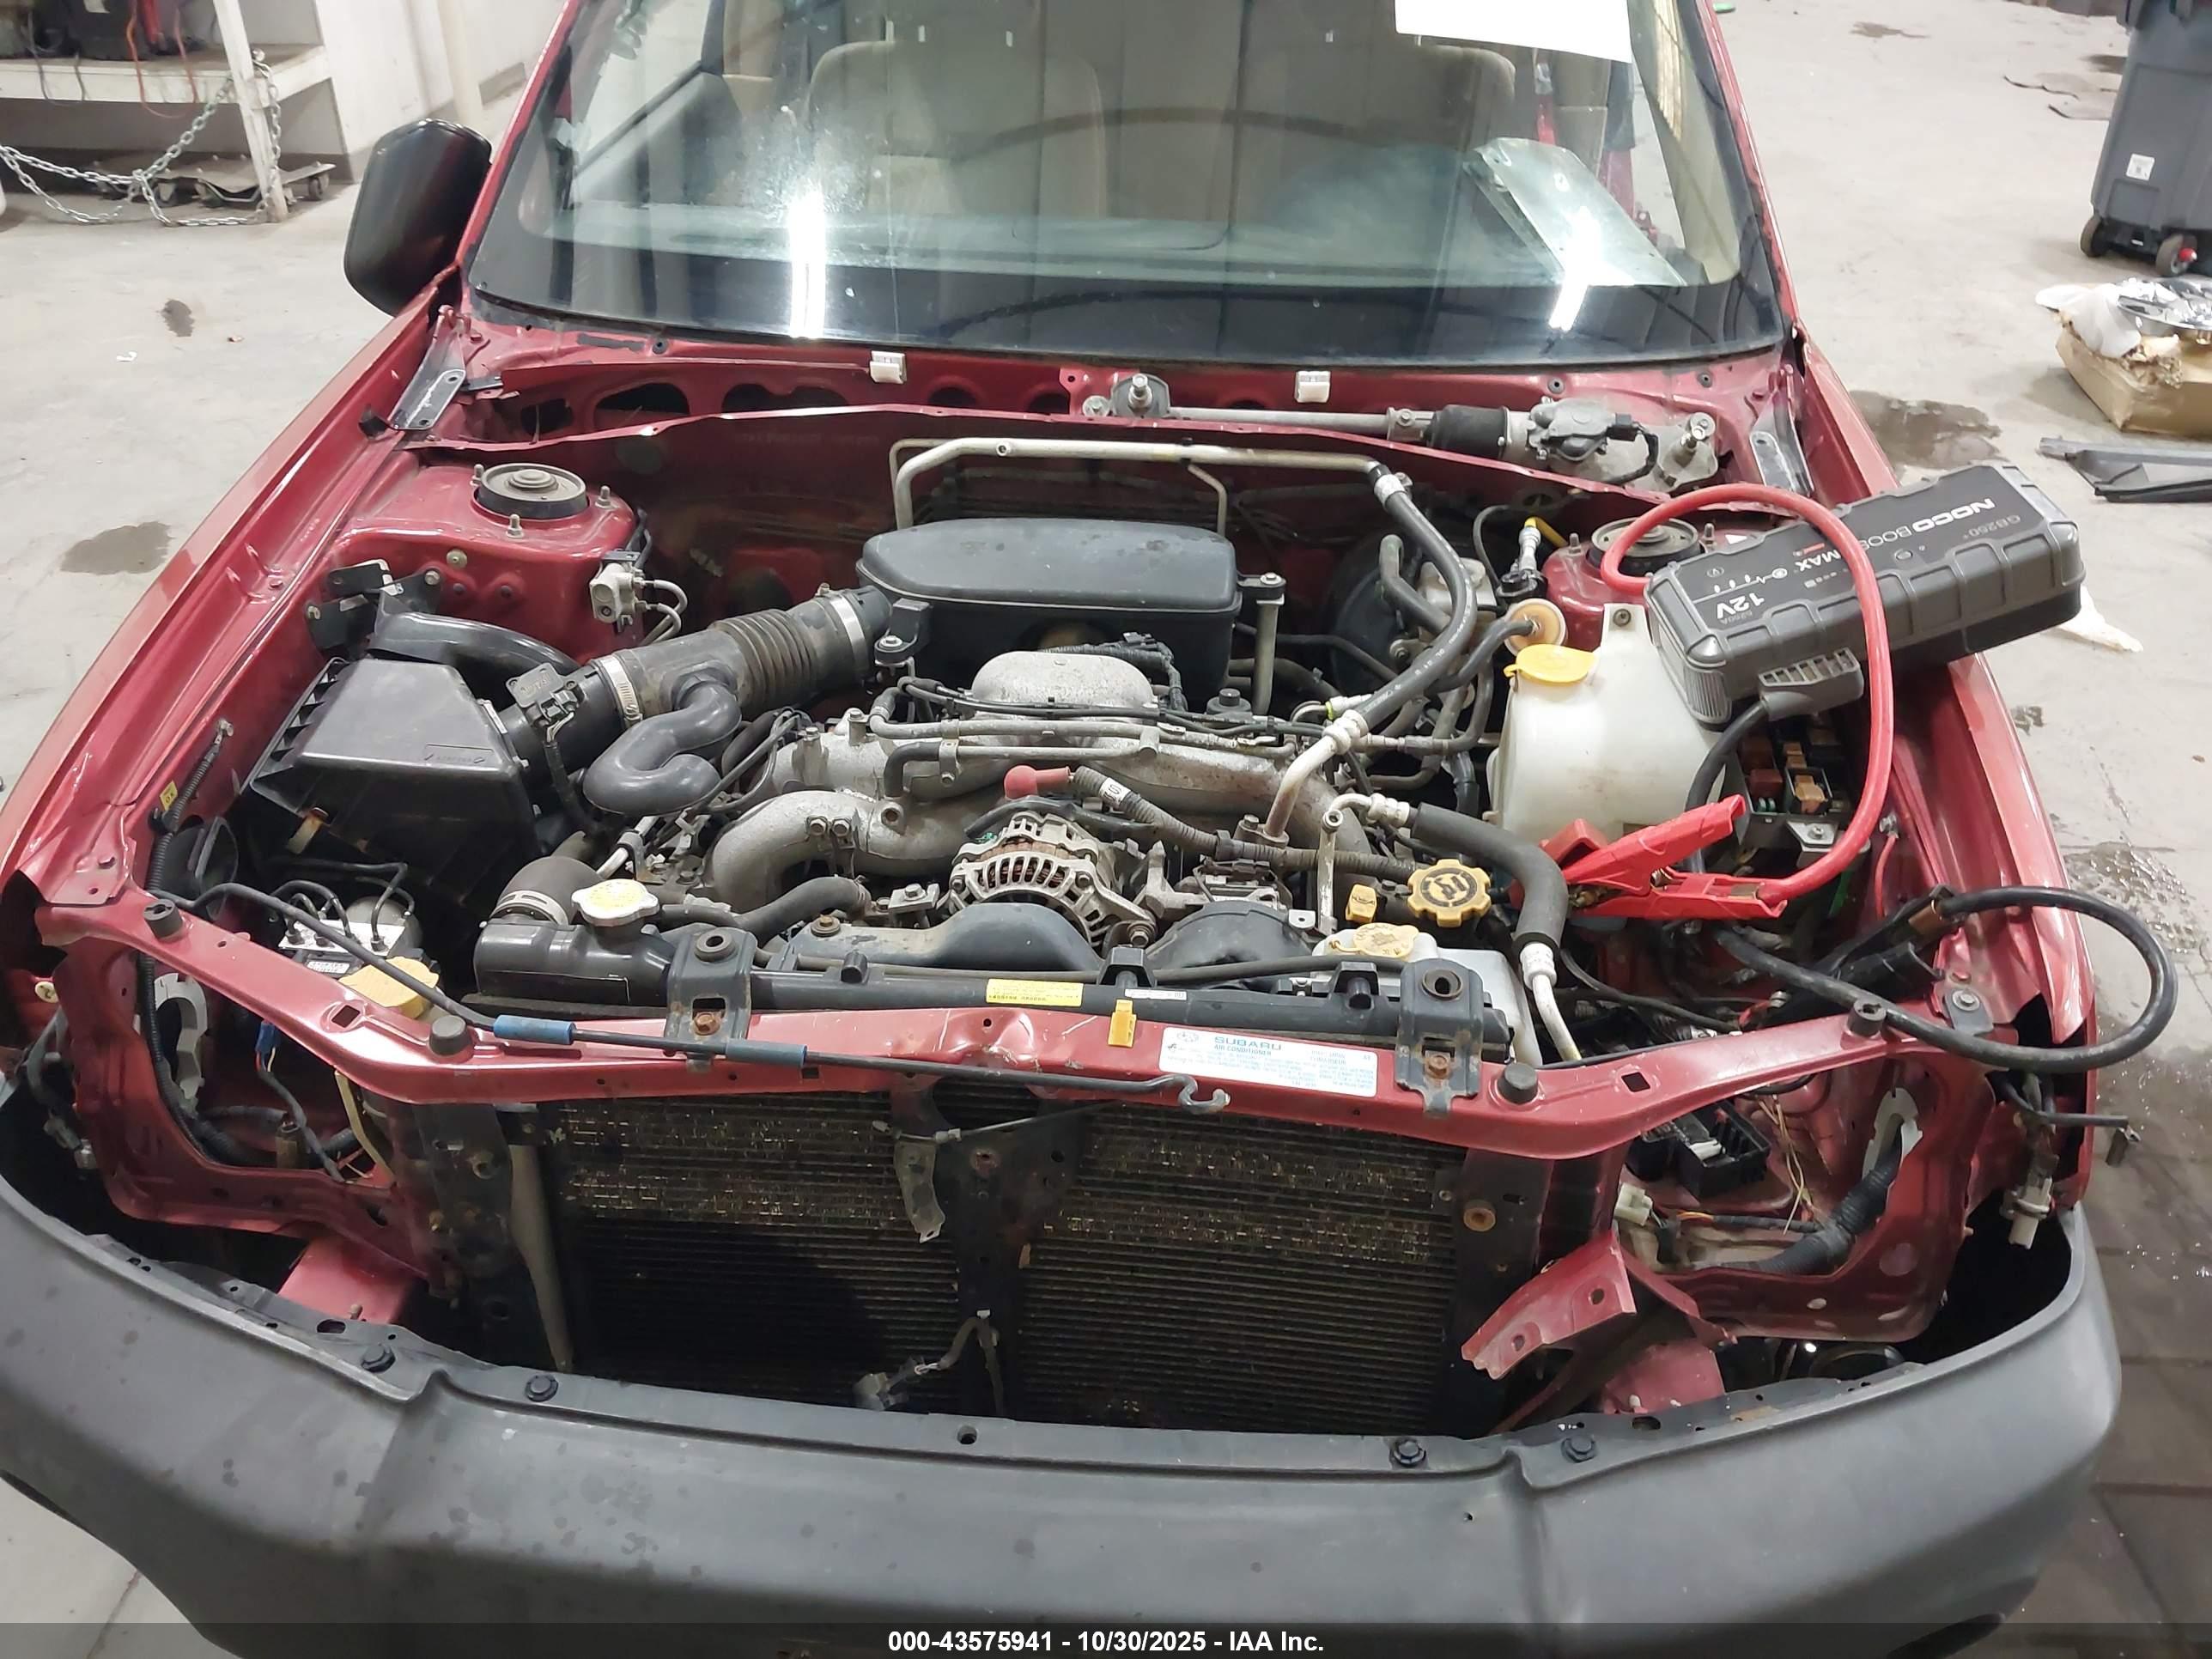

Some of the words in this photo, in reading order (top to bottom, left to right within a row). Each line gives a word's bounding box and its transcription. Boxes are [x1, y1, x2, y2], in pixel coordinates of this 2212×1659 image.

[1912, 498, 1996, 532] NOCO
[1795, 549, 1842, 572] MAX
[1717, 592, 1765, 619] 12V
[1213, 1036, 1282, 1051] SUBARU
